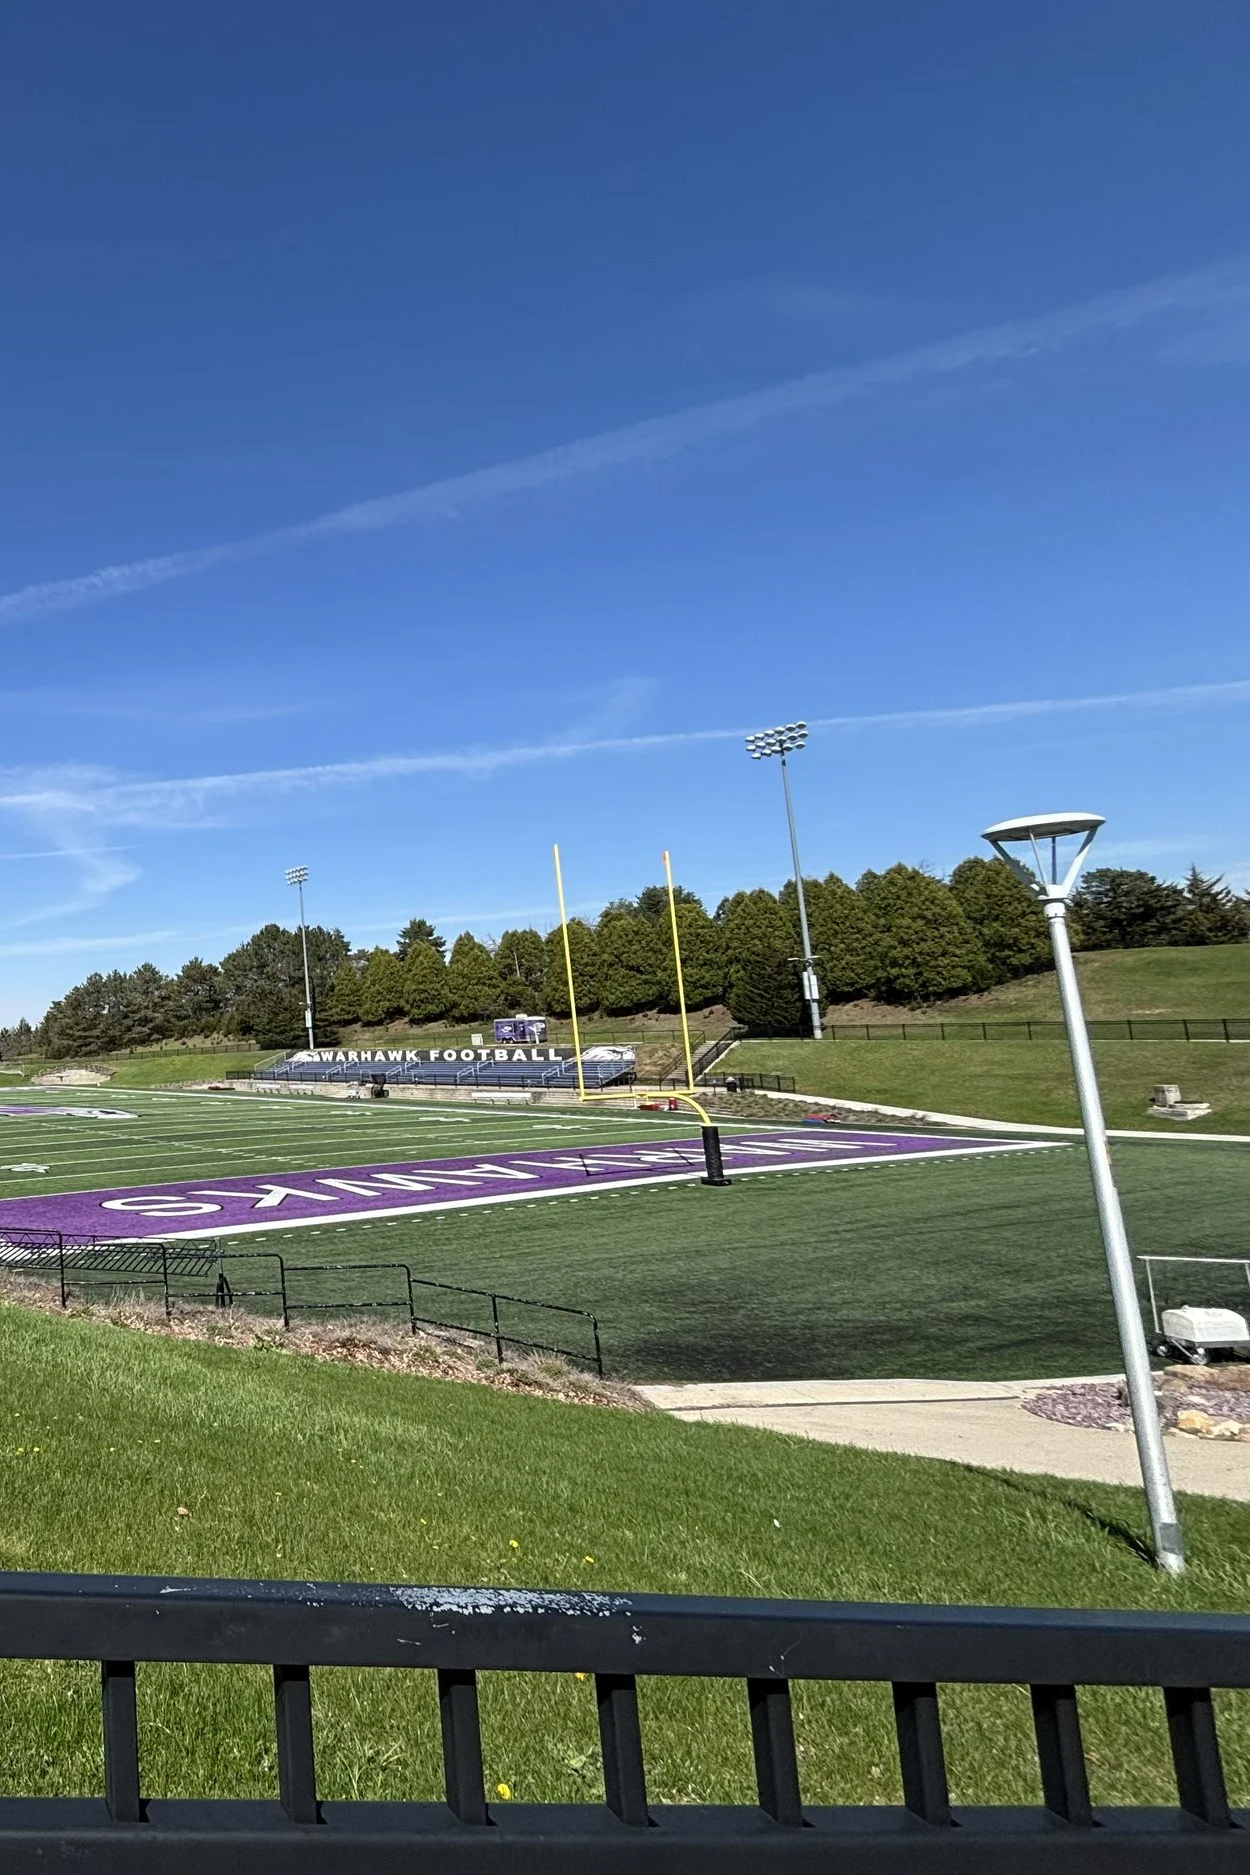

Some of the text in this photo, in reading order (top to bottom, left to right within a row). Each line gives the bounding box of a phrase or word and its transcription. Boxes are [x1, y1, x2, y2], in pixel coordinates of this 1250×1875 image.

[319, 1048, 563, 1062] WARHAWK FOOTBALL
[100, 1138, 898, 1218] WARHAWKS
